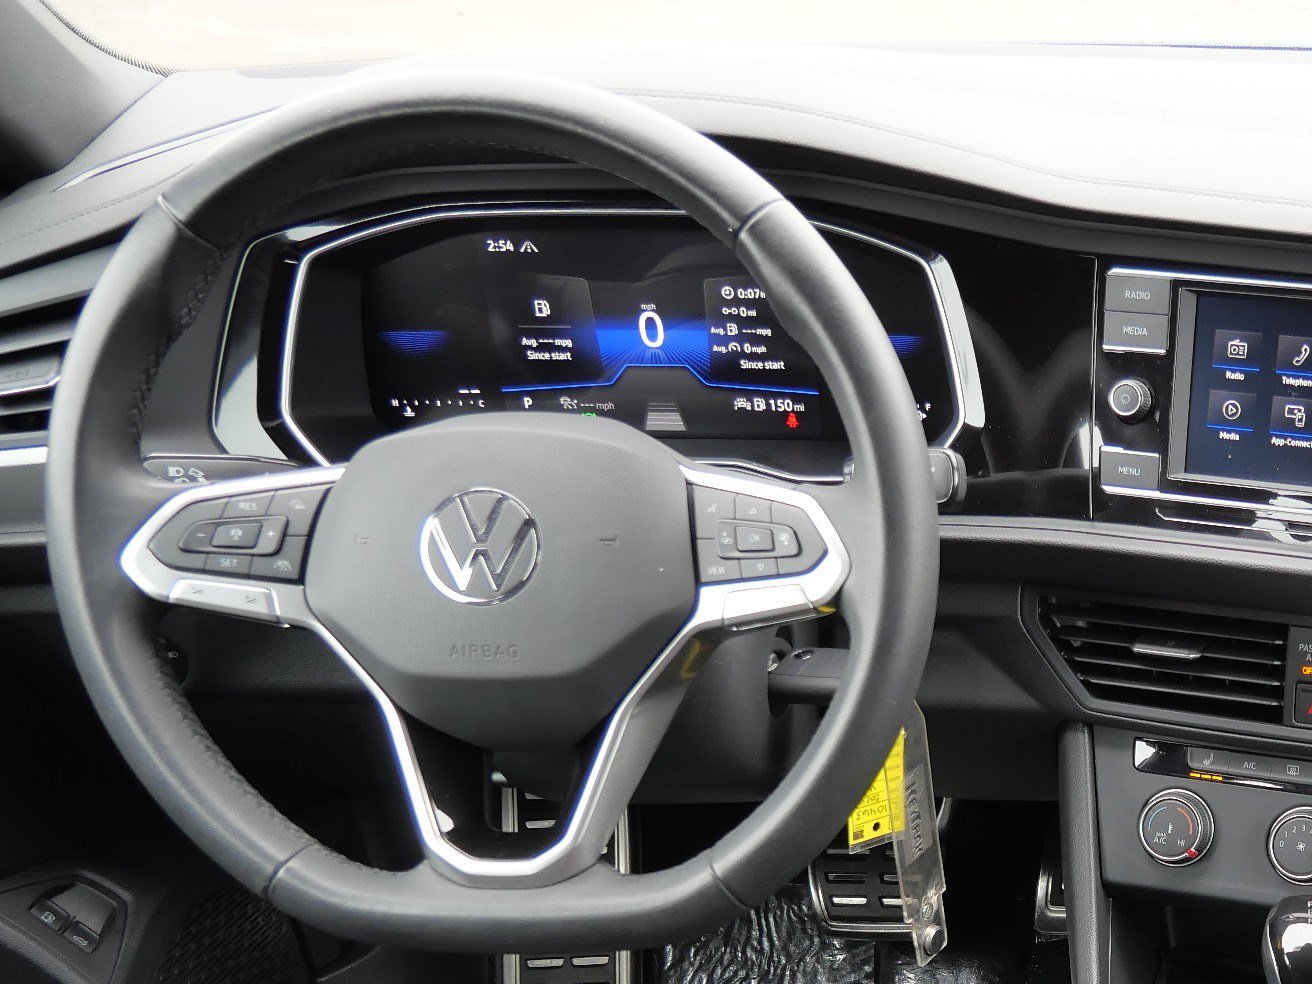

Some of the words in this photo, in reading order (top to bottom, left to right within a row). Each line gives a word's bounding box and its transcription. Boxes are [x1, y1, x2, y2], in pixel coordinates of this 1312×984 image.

[486, 240, 514, 252] 2:54
[1125, 289, 1150, 300] RADIO
[638, 311, 665, 348] 0
[1123, 326, 1148, 336] MEDIA
[527, 350, 550, 360] Since
[551, 351, 572, 360] start
[741, 360, 763, 369] Since
[764, 361, 785, 370] start
[1225, 371, 1245, 381] Radio
[524, 397, 532, 409] P
[596, 402, 615, 412] mph
[769, 399, 792, 411] 150
[1219, 431, 1239, 441] Media
[1118, 466, 1141, 476] MENU
[237, 502, 258, 511] RES
[220, 558, 238, 568] SET
[450, 644, 520, 660] AIRBAG
[1243, 761, 1257, 770] A/C
